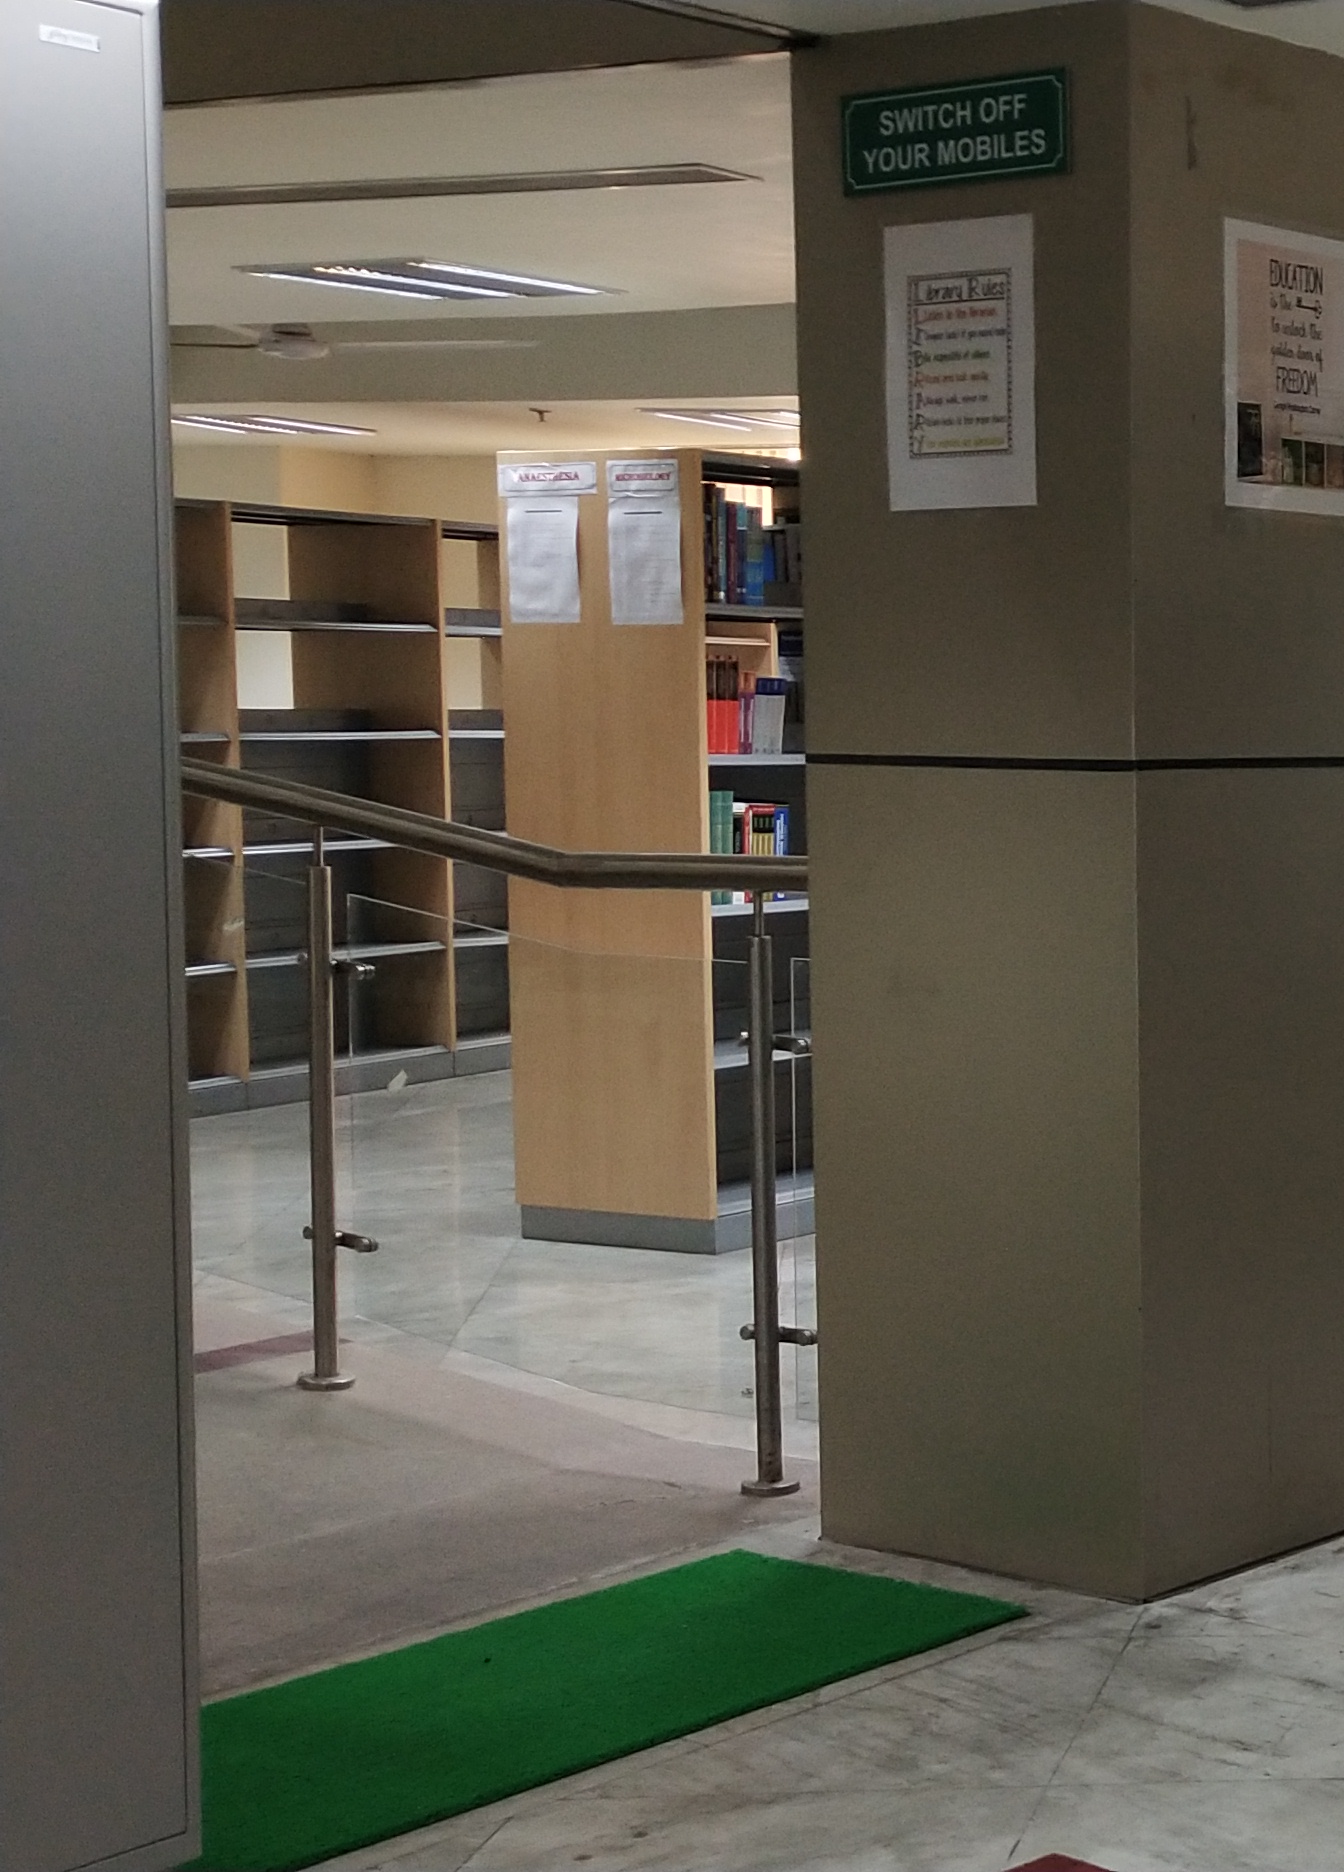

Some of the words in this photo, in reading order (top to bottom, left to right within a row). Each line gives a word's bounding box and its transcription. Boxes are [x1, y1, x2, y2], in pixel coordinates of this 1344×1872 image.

[879, 100, 972, 136] SWITCH
[979, 93, 1027, 124] OFF
[862, 143, 932, 174] YOUR
[937, 129, 1047, 167] MOBILES
[967, 277, 1005, 298] Rules
[1269, 258, 1324, 296] EDUCATION
[1276, 366, 1319, 398] FREEDOM
